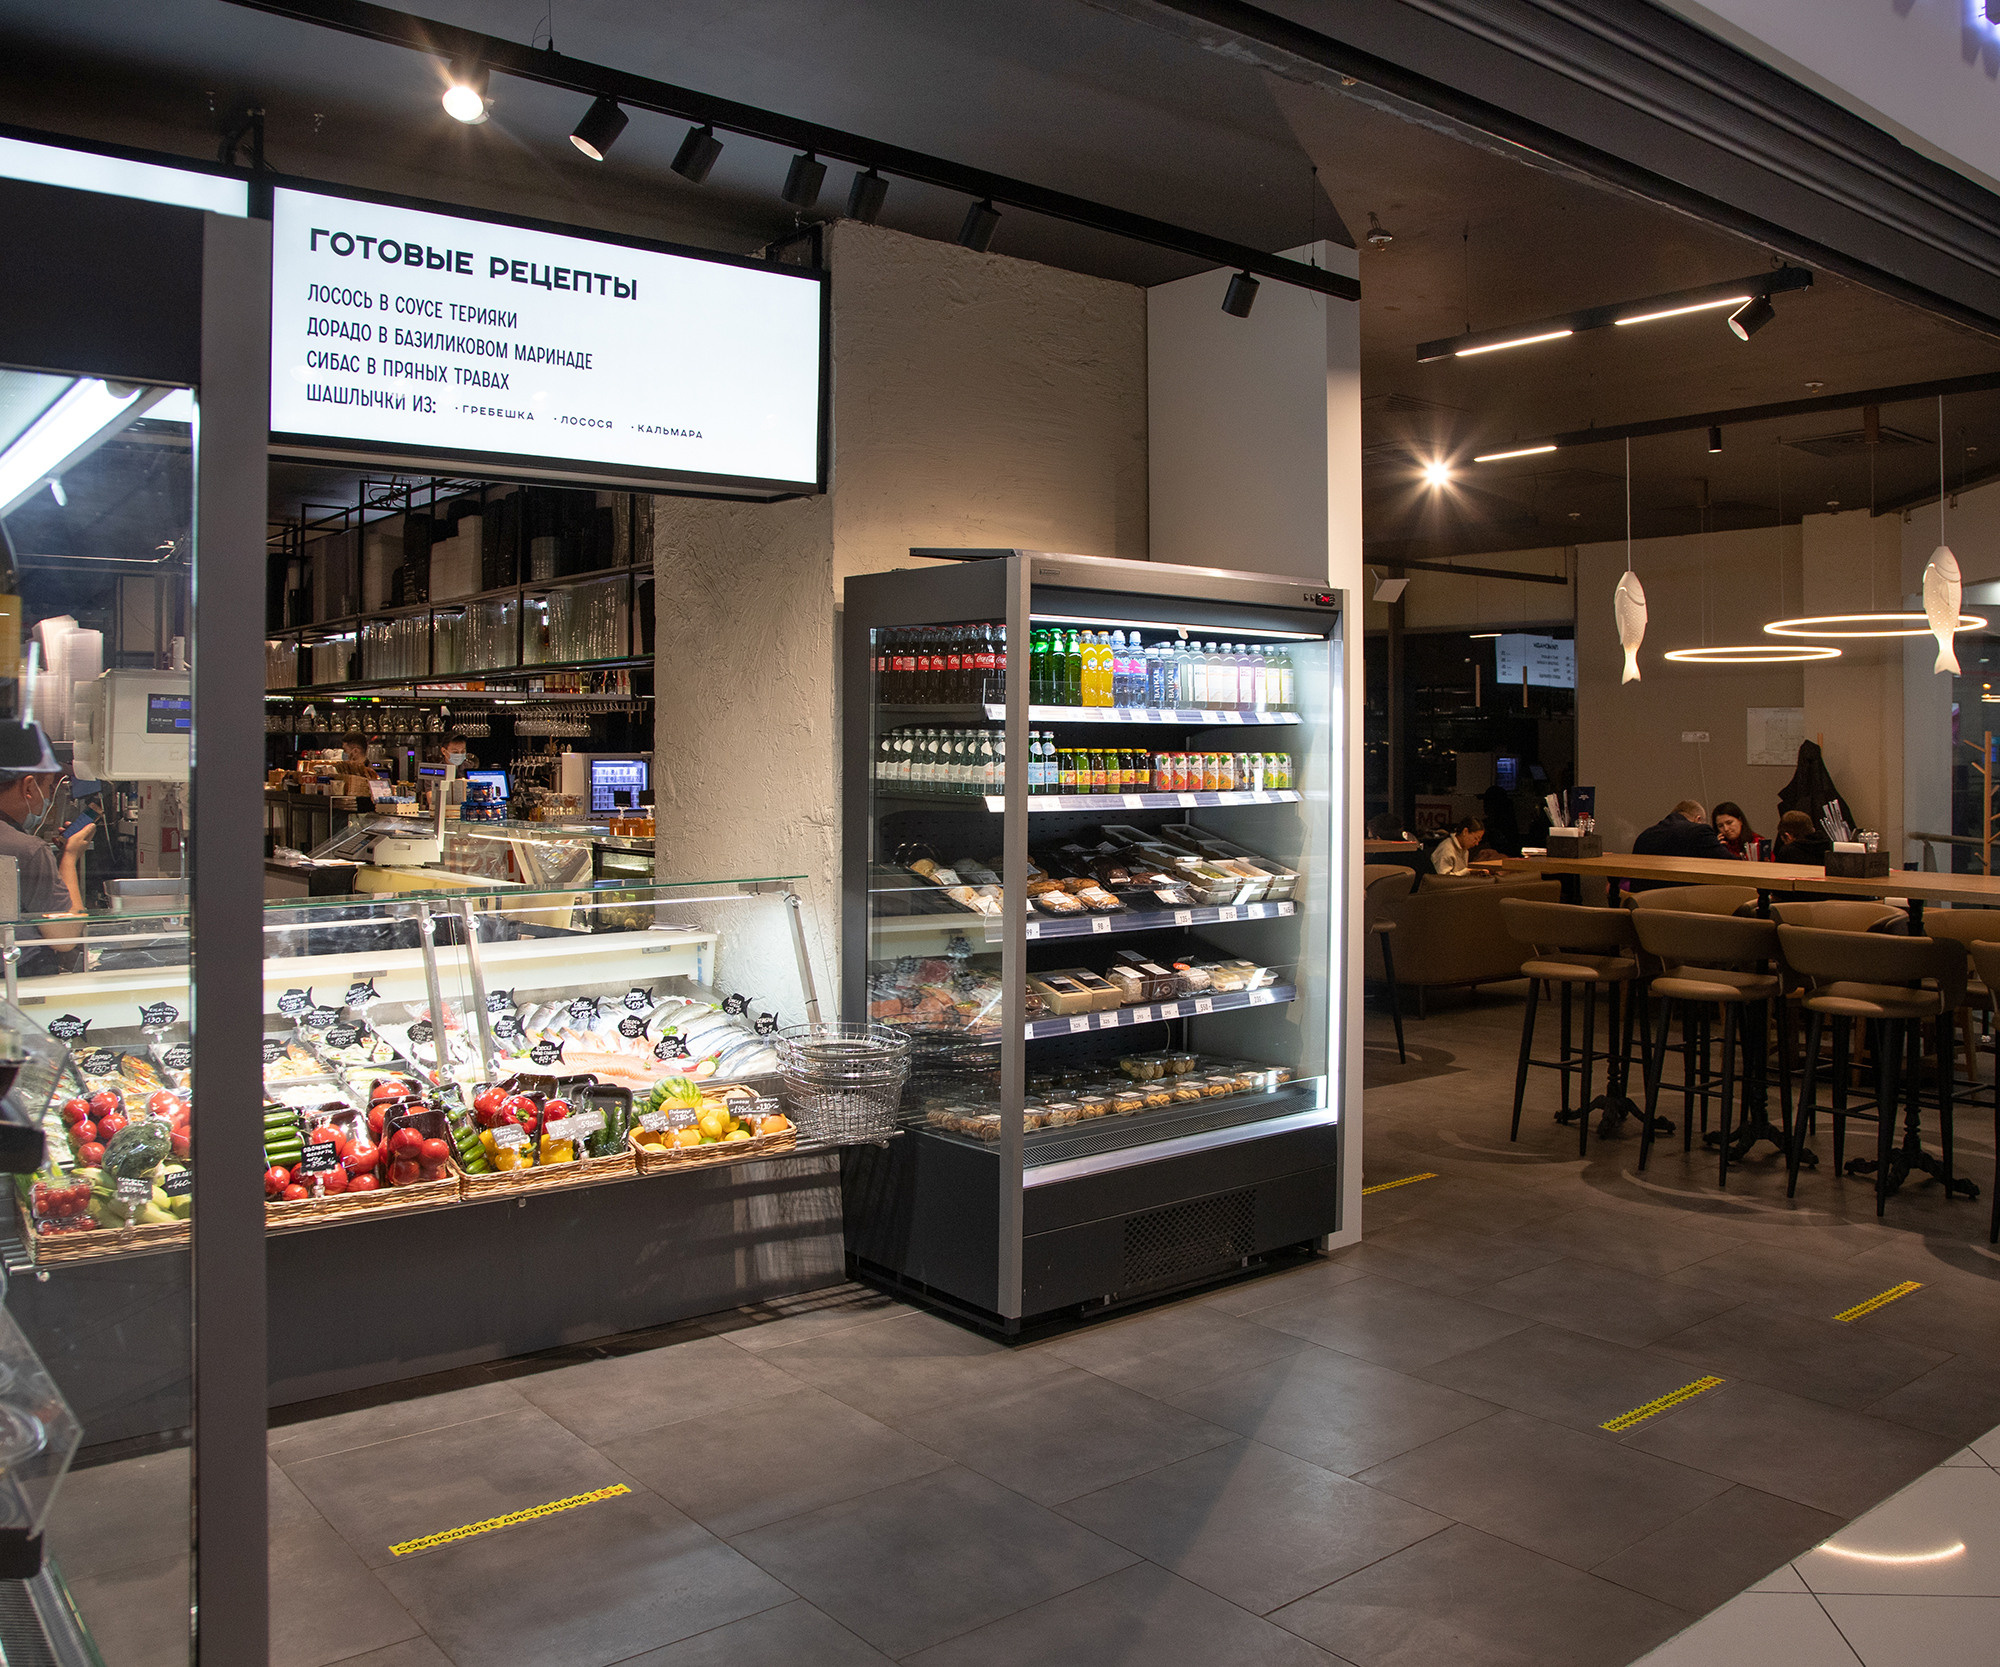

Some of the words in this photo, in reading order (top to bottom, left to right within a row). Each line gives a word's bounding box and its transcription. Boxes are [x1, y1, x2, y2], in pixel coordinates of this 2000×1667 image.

[310, 228, 474, 276] ГОТОВЫЕ
[489, 256, 638, 301] РЕЦЕПТЫ
[307, 283, 373, 309] ЛОСОСЬ
[379, 293, 389, 311] В
[395, 296, 443, 319] СОУСЕ
[449, 303, 518, 329] ТЕРИЯКИ
[306, 316, 372, 342] ДОРАДО
[378, 326, 388, 344] В
[394, 327, 508, 359] БАЗИЛИКОВОМ
[514, 343, 593, 371] МАРИНАДЕ
[306, 350, 361, 373] СИБАС
[367, 357, 377, 375] В
[383, 359, 448, 383] ПРЯНЫХ
[454, 366, 510, 391] ТРАВАХ
[306, 383, 406, 411] ШАШЛЫЧКИ
[412, 394, 437, 414] ИЗ:
[462, 404, 535, 421] ГРЕБЕШКА
[560, 415, 613, 430] ЛОСОСЯ
[637, 424, 703, 439] КАЛЬМАРА
[396, 1520, 500, 1552] СОБЛЮДАЙТЕ
[503, 1496, 590, 1524] ДИСТАНЦИЮ
